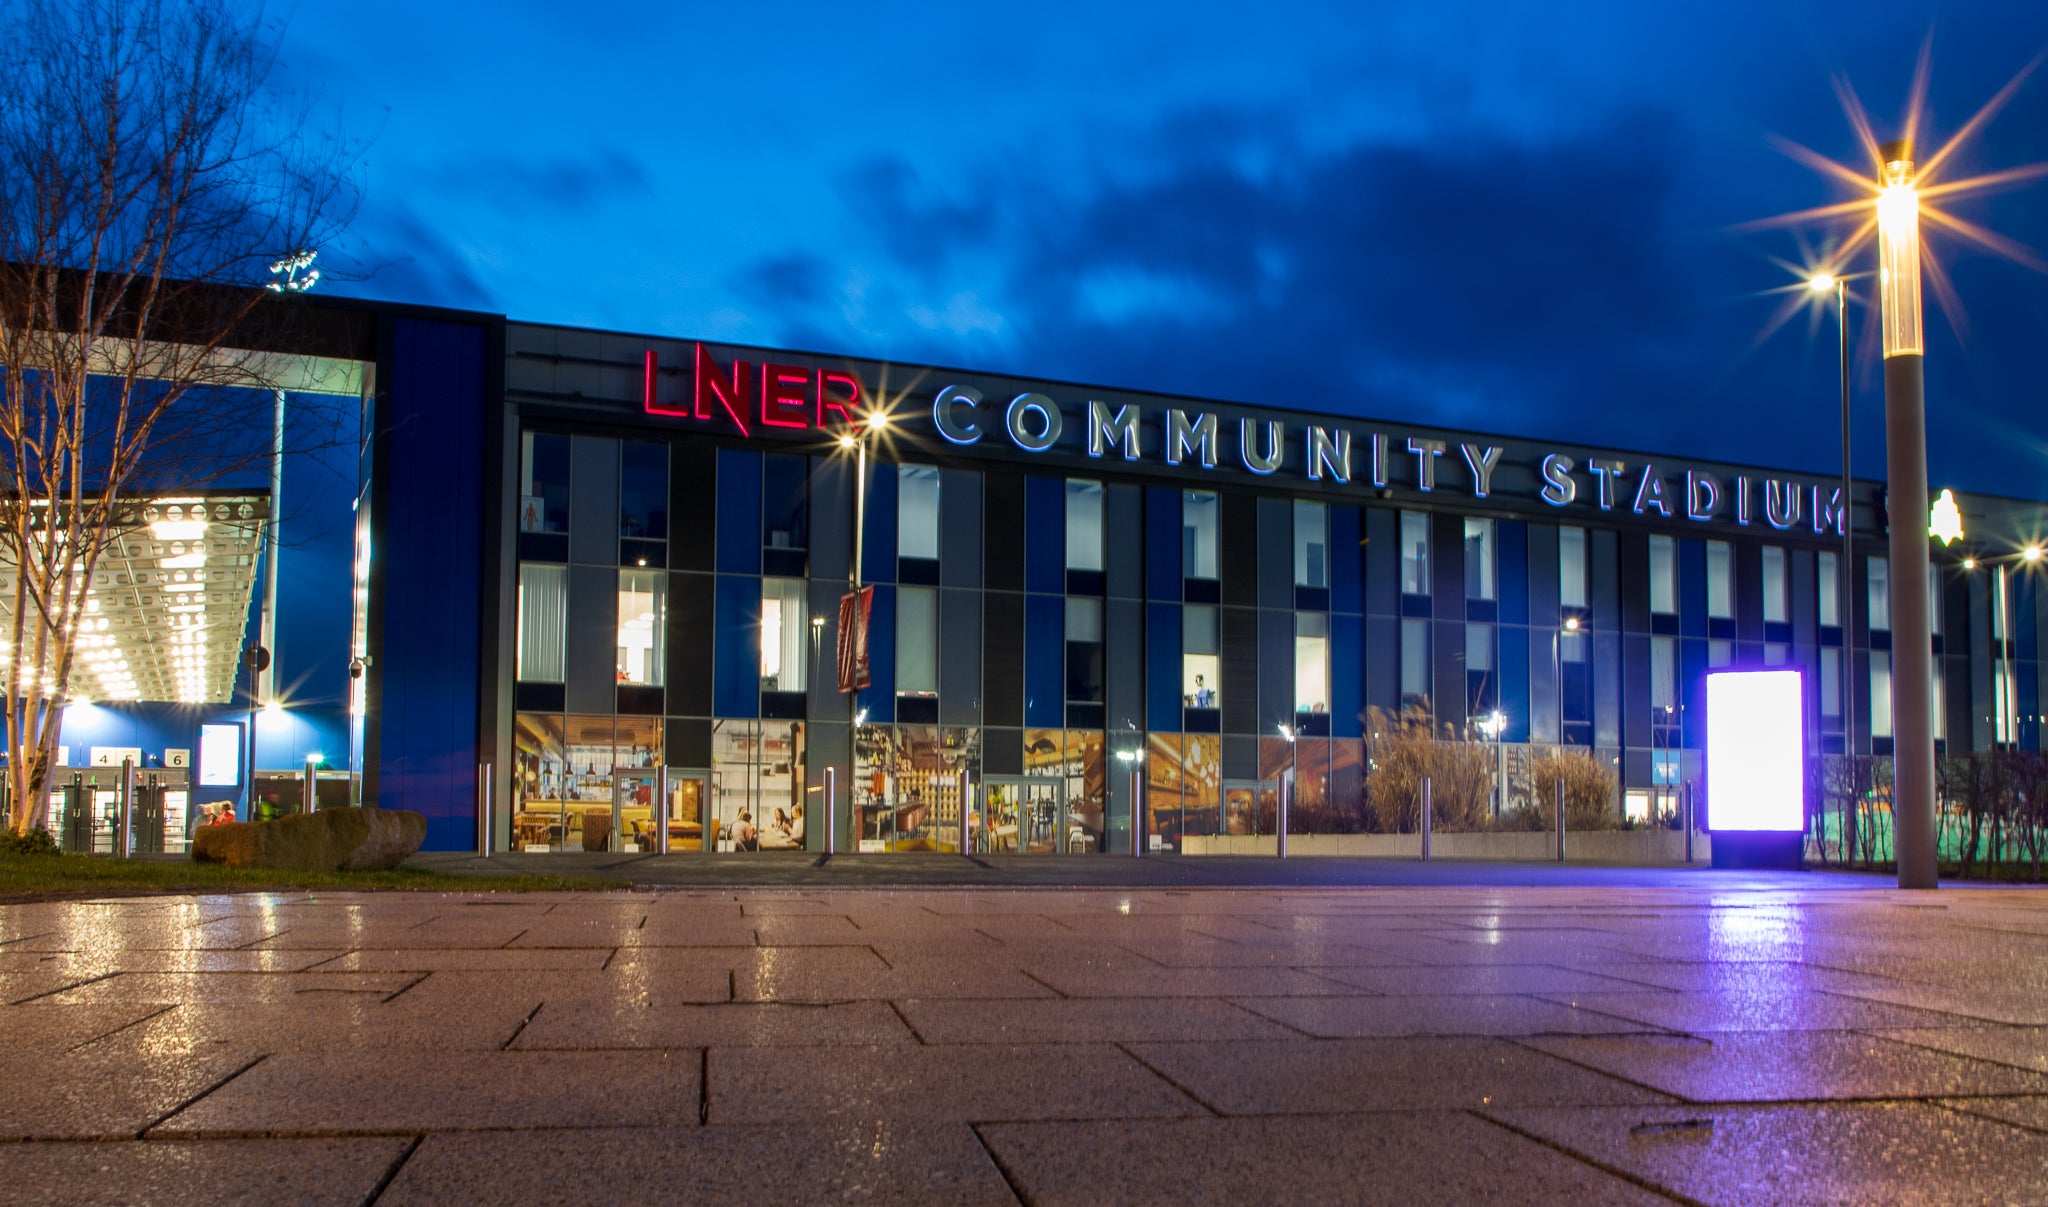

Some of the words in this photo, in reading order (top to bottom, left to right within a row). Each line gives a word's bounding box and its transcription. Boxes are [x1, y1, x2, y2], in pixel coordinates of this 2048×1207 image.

[645, 341, 863, 437] LNER
[933, 384, 1503, 497] COMMUNITY
[1541, 452, 1847, 536] STADIUM
[99, 755, 107, 764] 4
[173, 755, 181, 766] 6
